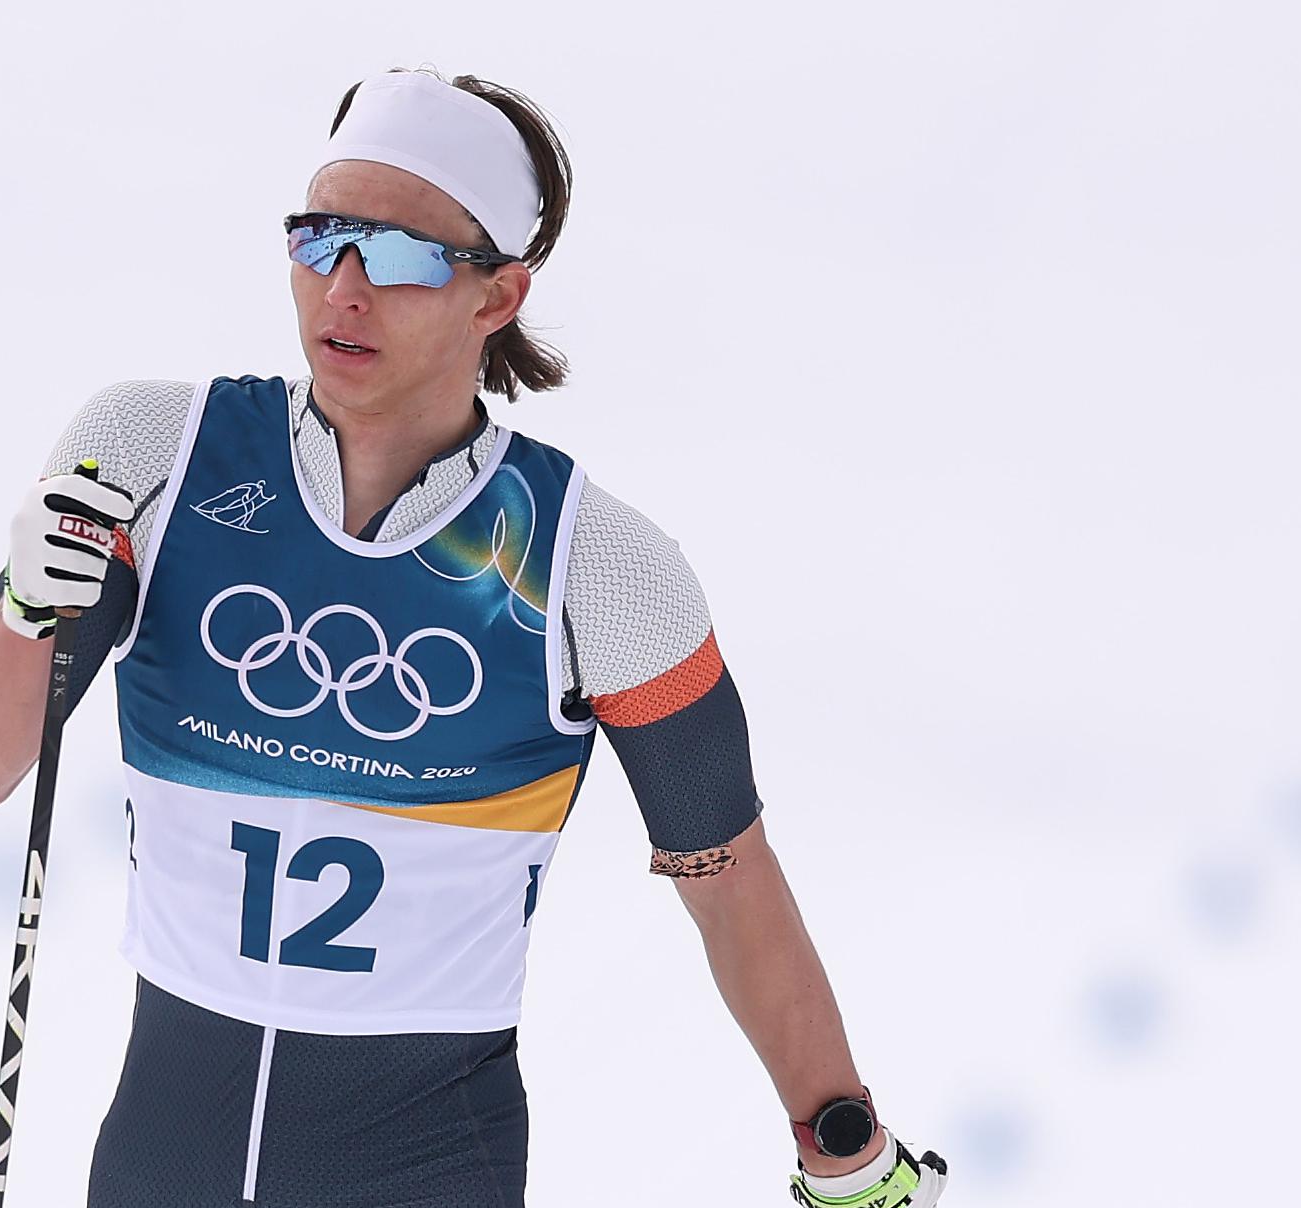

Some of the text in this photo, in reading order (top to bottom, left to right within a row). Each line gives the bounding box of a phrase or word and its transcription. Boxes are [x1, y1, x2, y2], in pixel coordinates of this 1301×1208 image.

[178, 715, 284, 757] MILANO
[289, 744, 414, 779] CORTINA
[230, 820, 386, 973] 12
